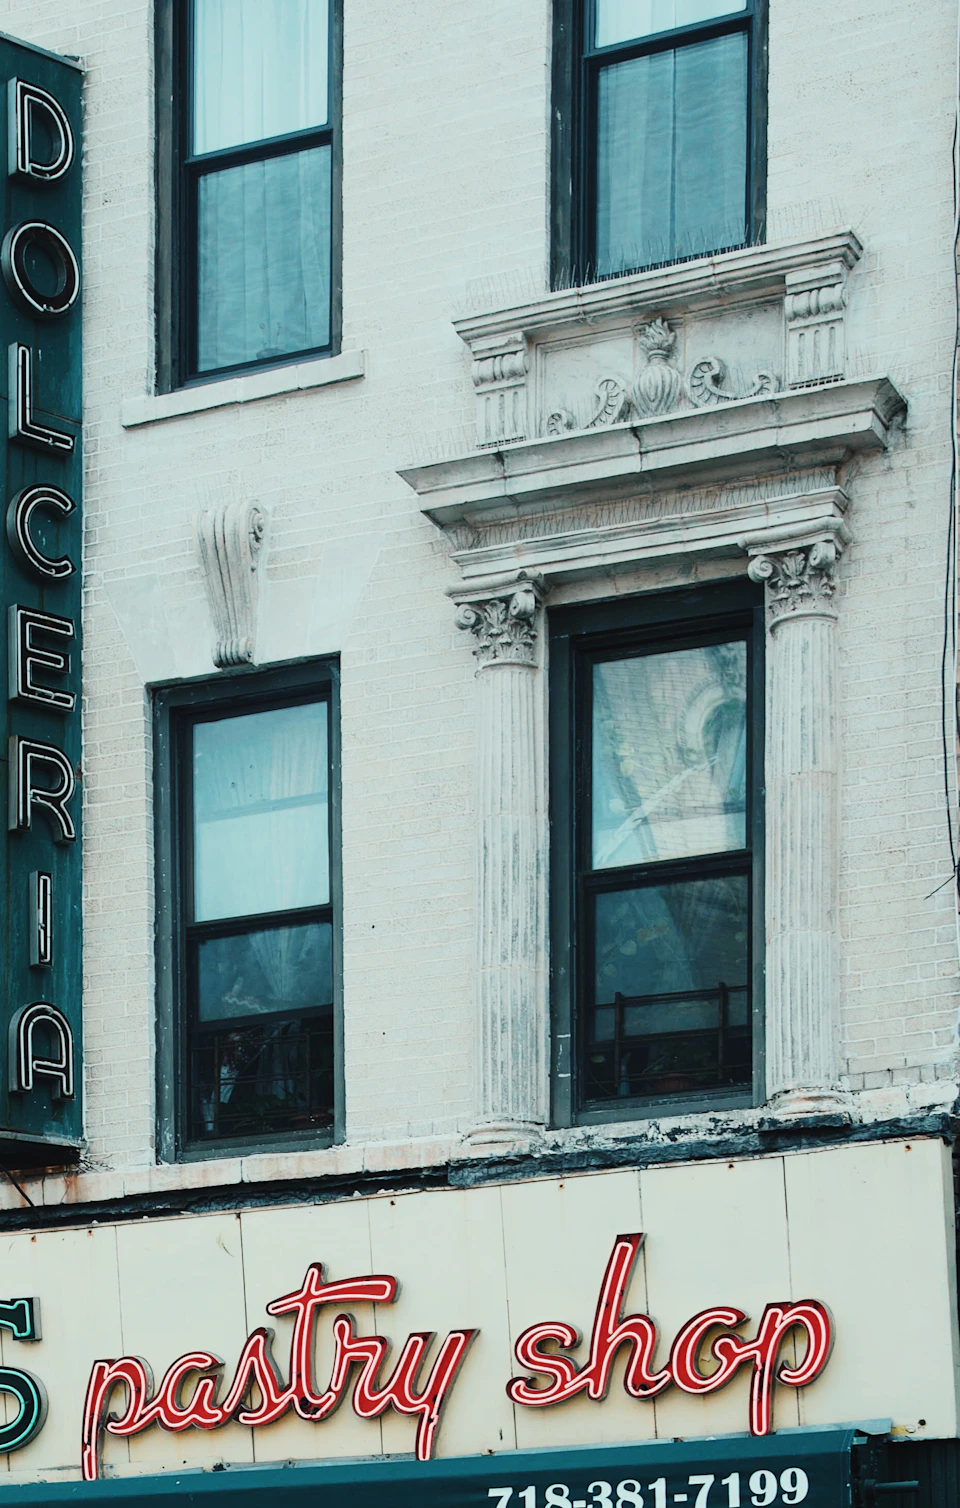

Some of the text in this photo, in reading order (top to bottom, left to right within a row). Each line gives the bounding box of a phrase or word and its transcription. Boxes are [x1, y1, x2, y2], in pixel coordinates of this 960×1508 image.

[1, 76, 81, 1100] DOLCERIA
[81, 1262, 481, 1481] pastry
[506, 1232, 836, 1437] shop
